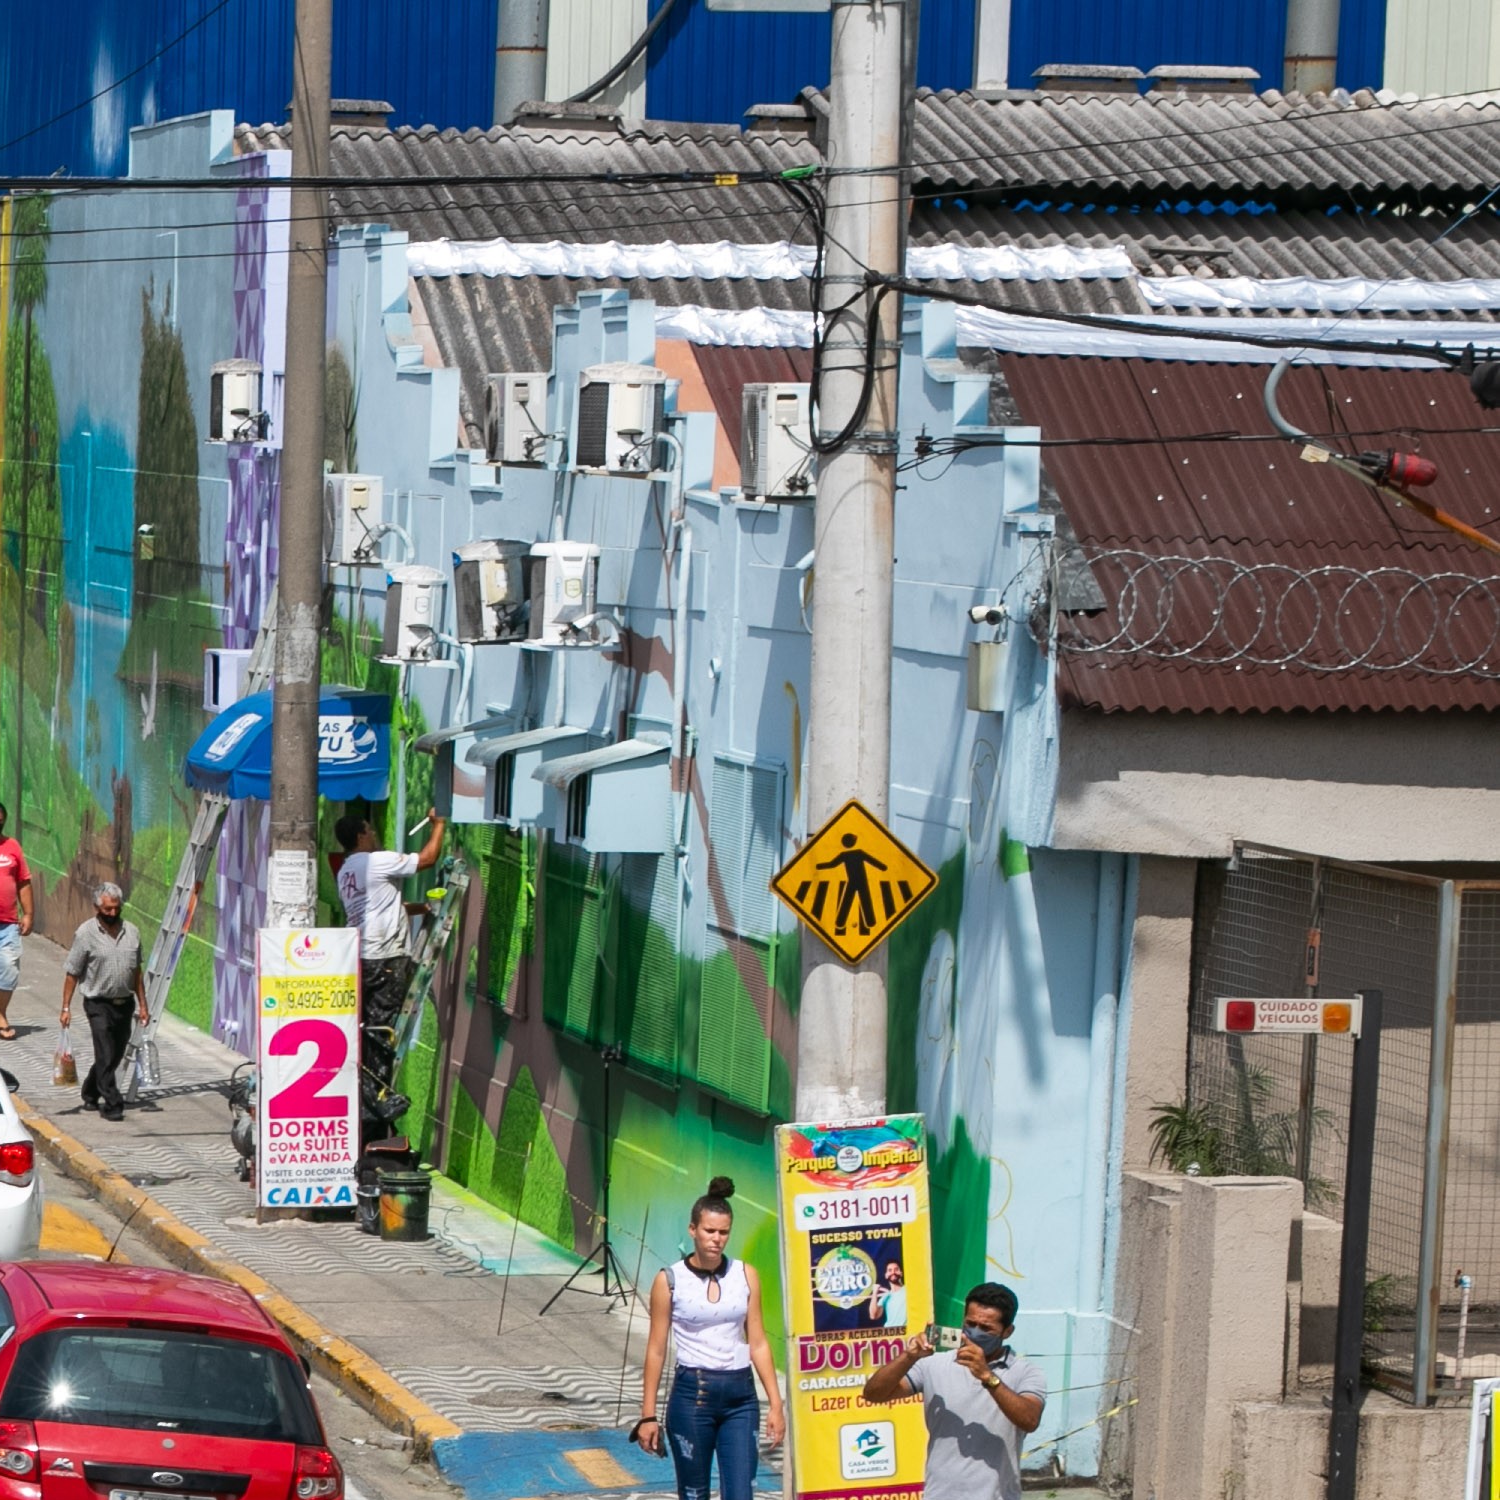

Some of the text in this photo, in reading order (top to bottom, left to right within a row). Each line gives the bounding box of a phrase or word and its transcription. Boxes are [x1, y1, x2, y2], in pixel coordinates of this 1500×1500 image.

[275, 978, 350, 990] INFORMAÇÕES
[1260, 1002, 1318, 1012] CUIDADO
[268, 1019, 348, 1119] 2
[269, 1120, 349, 1138] DORMS
[269, 1142, 300, 1152] COM
[786, 1145, 924, 1173] Parque Imperial
[265, 1169, 293, 1177] VISITE
[295, 1169, 302, 1177] O
[267, 1185, 352, 1205] CAIXA
[819, 1194, 910, 1220] 3181-0011
[811, 1227, 902, 1244] SUCESSO TOTAL
[816, 1263, 871, 1276] ENTRADA
[818, 1274, 873, 1292] ZERO
[816, 1327, 906, 1342] OBRAS ACELERADAS
[800, 1338, 915, 1372] Dorm
[799, 1374, 867, 1391] GARAGEM
[812, 1395, 851, 1412] Lazer
[848, 1458, 890, 1468] CASA VERDE
[856, 1466, 888, 1474] AMARELA
